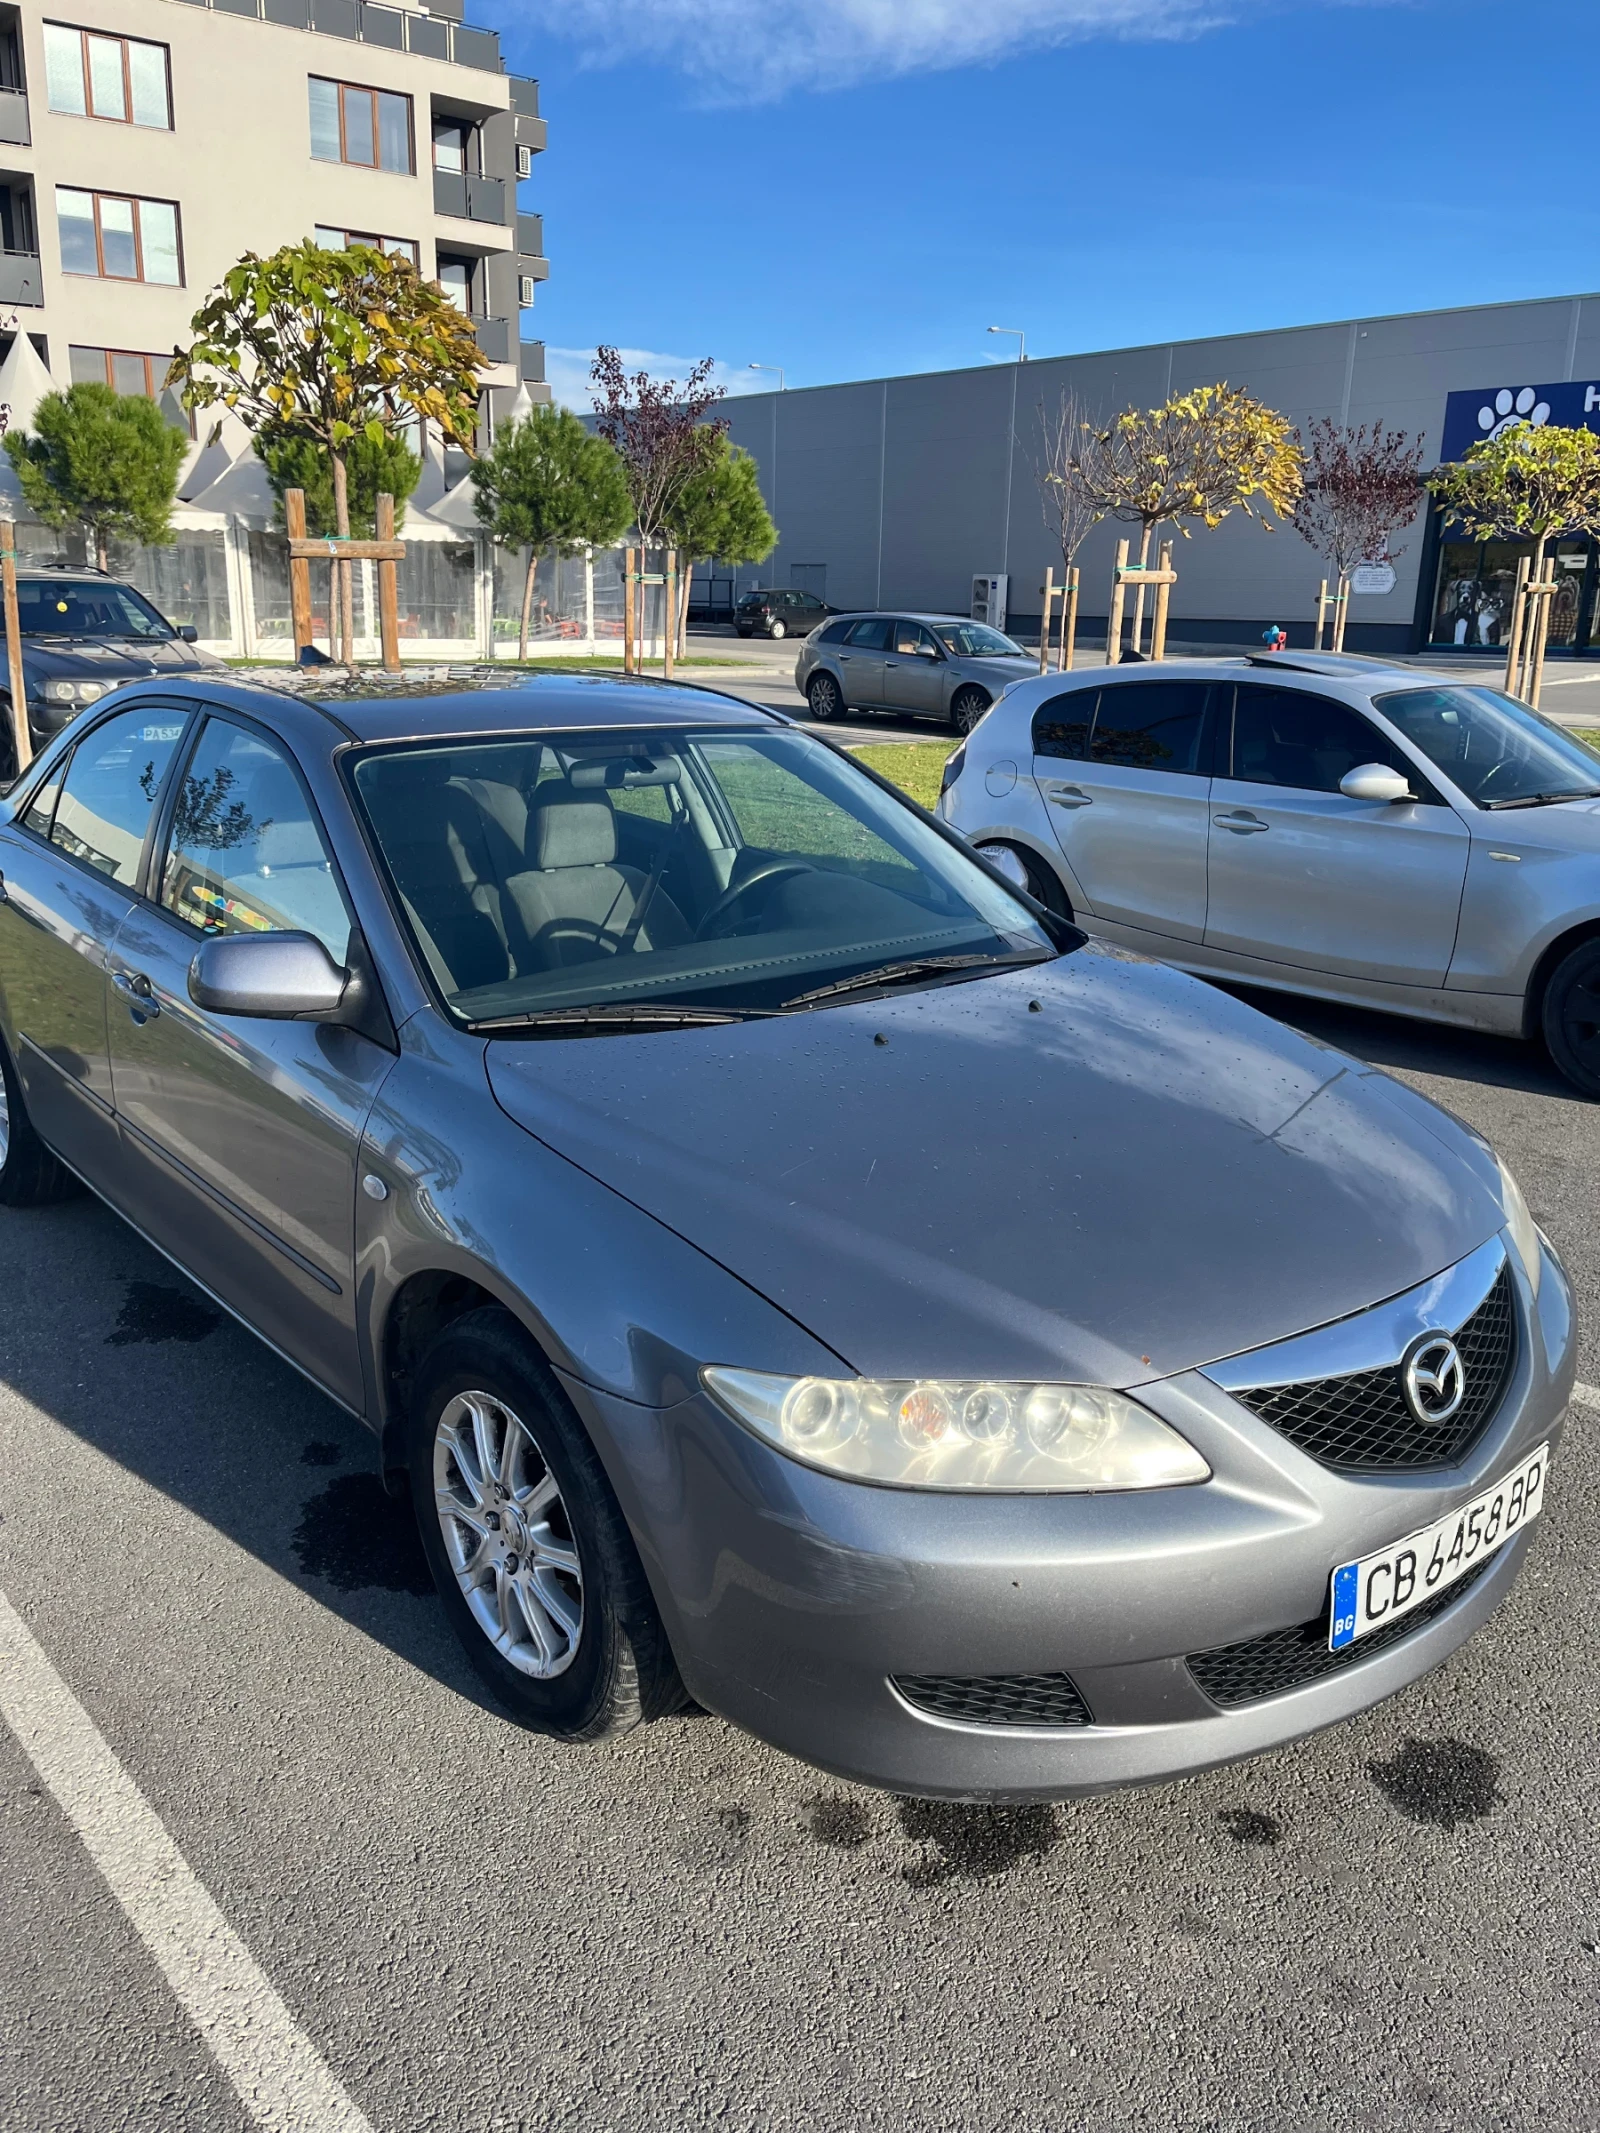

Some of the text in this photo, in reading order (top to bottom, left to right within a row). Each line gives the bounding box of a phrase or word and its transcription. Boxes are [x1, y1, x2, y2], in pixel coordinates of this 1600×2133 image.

[145, 730, 160, 739] PA
[1366, 1461, 1541, 1620] CB 6458 BP
[1334, 1614, 1354, 1636] BG
